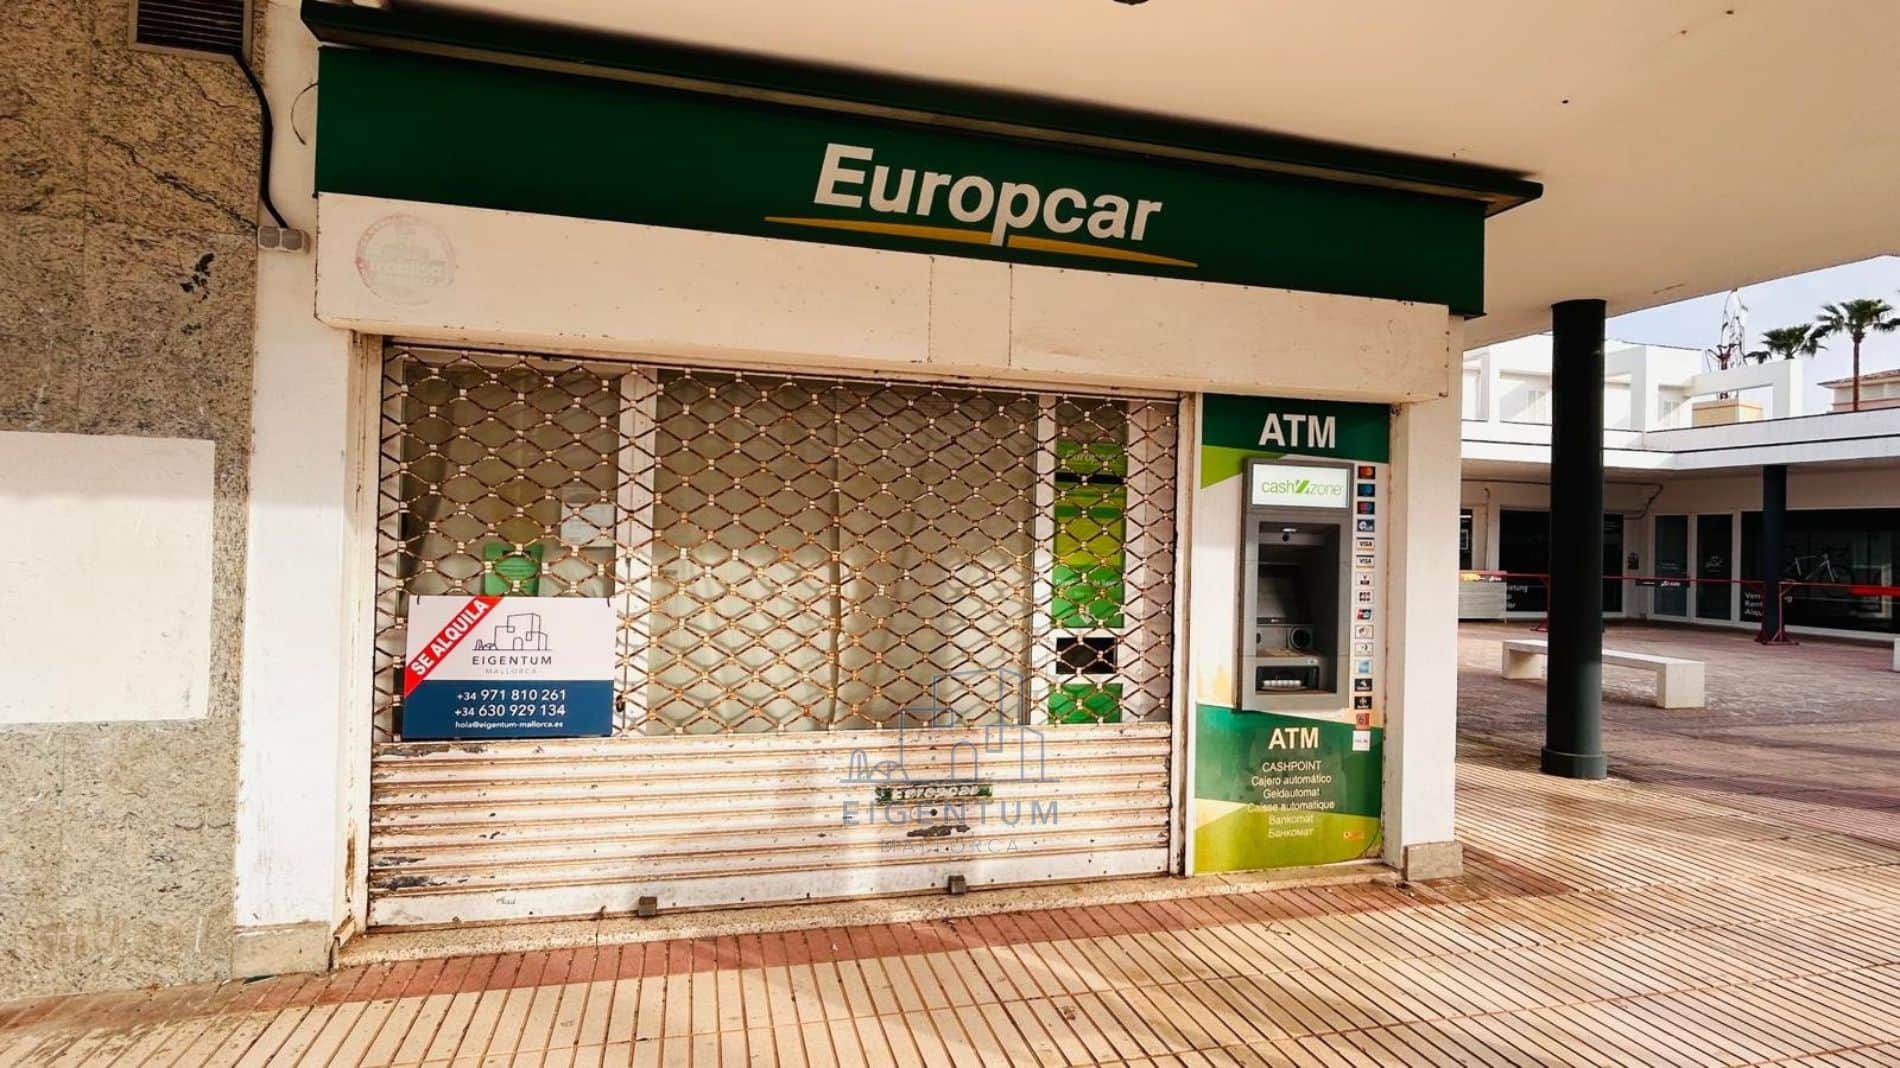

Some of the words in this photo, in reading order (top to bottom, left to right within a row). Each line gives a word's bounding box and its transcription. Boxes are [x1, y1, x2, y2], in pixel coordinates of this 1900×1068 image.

[813, 142, 1163, 247] Europcar
[1258, 412, 1337, 449] ATM
[410, 653, 435, 676] SE
[432, 599, 490, 658] ALQUILA
[471, 655, 552, 665] EIGENTUM
[457, 691, 477, 701] +34
[480, 688, 505, 701] 971
[511, 689, 538, 701] 810
[541, 688, 566, 701] 261
[454, 706, 475, 717] +34
[478, 704, 505, 717] 630
[509, 704, 536, 717] 929
[540, 704, 566, 717] 134
[455, 720, 564, 730] hola@eigentum-mallorca.es
[1268, 727, 1319, 750] ATM
[1262, 760, 1322, 772] CASHPOINT
[1251, 776, 1281, 787] Cajero
[1282, 773, 1332, 785] automático
[1263, 788, 1320, 799] Geldautomat
[1280, 800, 1335, 811] automatique
[1268, 815, 1314, 825] Bankomat
